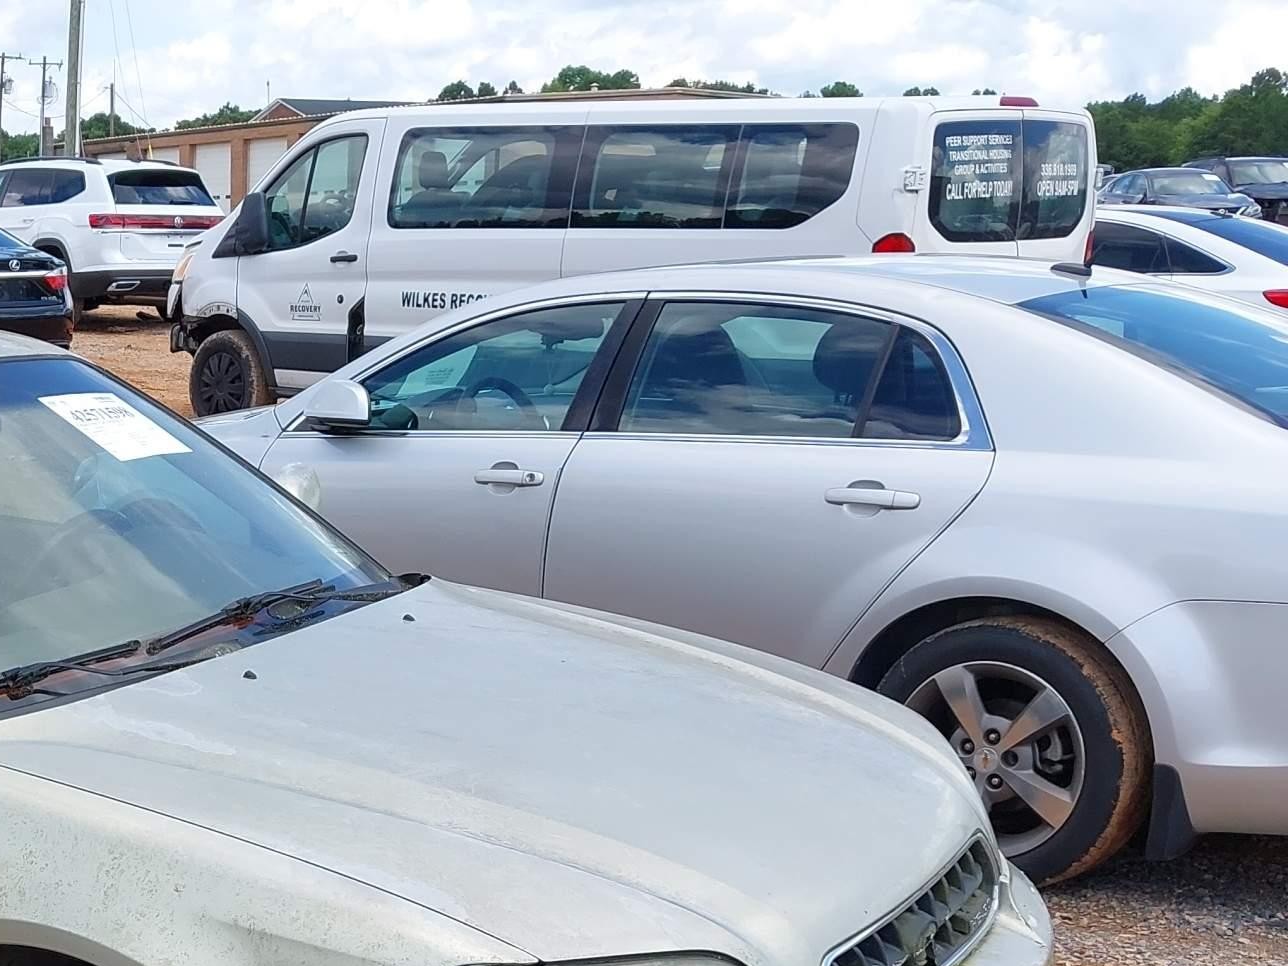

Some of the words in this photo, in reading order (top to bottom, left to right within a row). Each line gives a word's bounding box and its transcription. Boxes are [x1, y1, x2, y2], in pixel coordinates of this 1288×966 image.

[945, 135, 961, 147] PEER
[962, 134, 988, 146] SUPPORT
[988, 134, 1013, 145] SERVICES
[949, 149, 988, 162] TRANSITIONAL
[989, 149, 1012, 160] HOUSING
[954, 163, 975, 176] GROUP
[980, 162, 1008, 174] ACTIVITIES
[946, 183, 963, 200] CALL
[964, 182, 977, 199] FOR
[977, 181, 993, 198] HELP
[1036, 179, 1054, 198] OPEN
[401, 291, 446, 309] WILKES
[289, 304, 321, 313] RECOVERY
